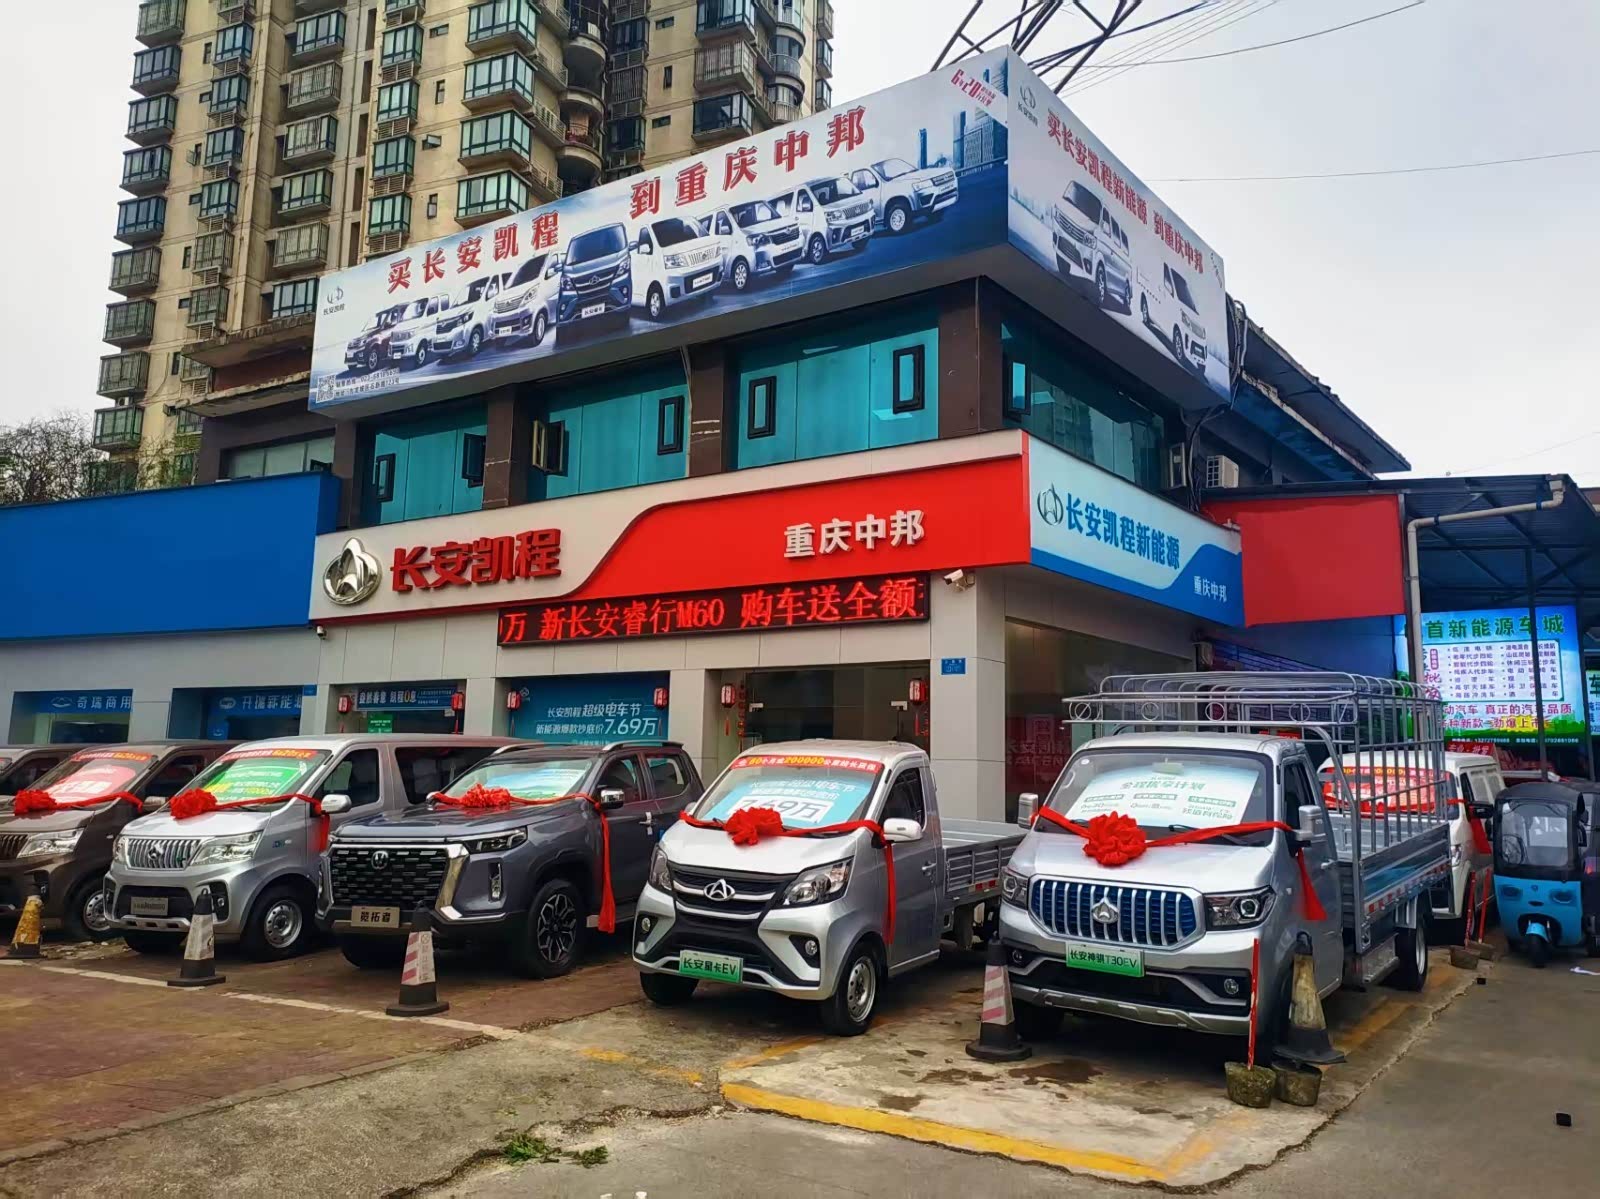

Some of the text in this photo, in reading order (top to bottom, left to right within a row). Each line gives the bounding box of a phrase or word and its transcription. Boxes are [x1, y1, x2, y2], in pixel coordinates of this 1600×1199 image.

[388, 105, 867, 292] 买长安凯程 到重庆中邦
[1047, 110, 1148, 225] 买长安凯程新能源
[1153, 210, 1205, 275] 到重庆中邦
[784, 509, 925, 559] 重庆中邦
[1066, 493, 1180, 570] 长安凯程新能源
[390, 528, 562, 592] 长安凯程
[1193, 575, 1228, 603] 重庆中邦
[539, 596, 726, 640] 新长安睿行M60
[548, 702, 642, 718] 长安凯程超级电车节
[683, 956, 738, 976] 长安星卡EV
[1070, 950, 1138, 969] 长安神骐T30EV
